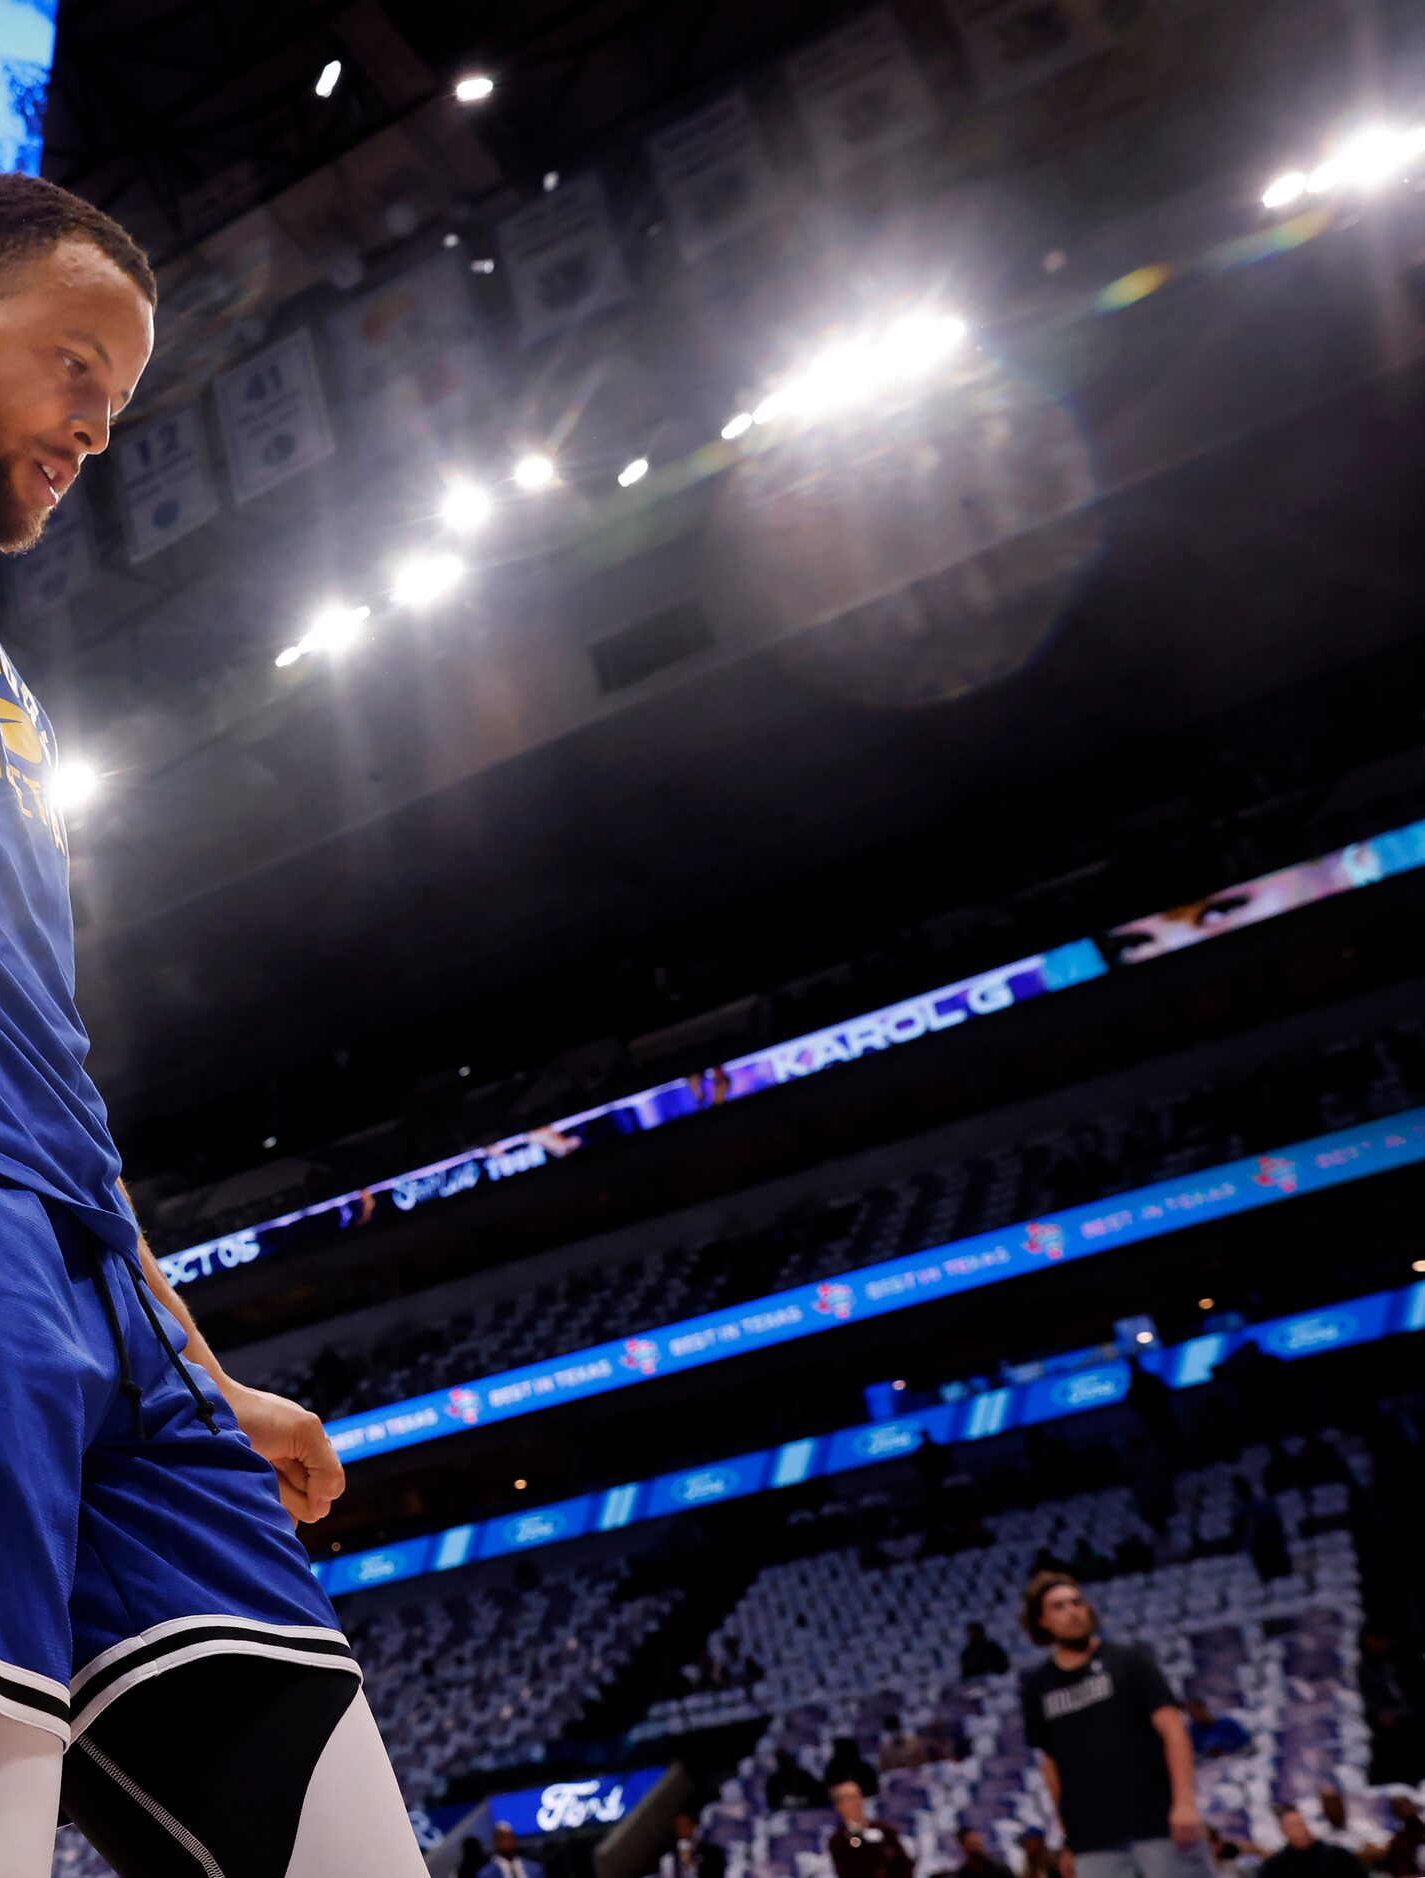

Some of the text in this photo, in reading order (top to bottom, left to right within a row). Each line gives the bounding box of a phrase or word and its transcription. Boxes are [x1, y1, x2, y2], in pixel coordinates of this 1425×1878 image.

[774, 973, 1014, 1083] KAROL G
[330, 1427, 364, 1452] EST
